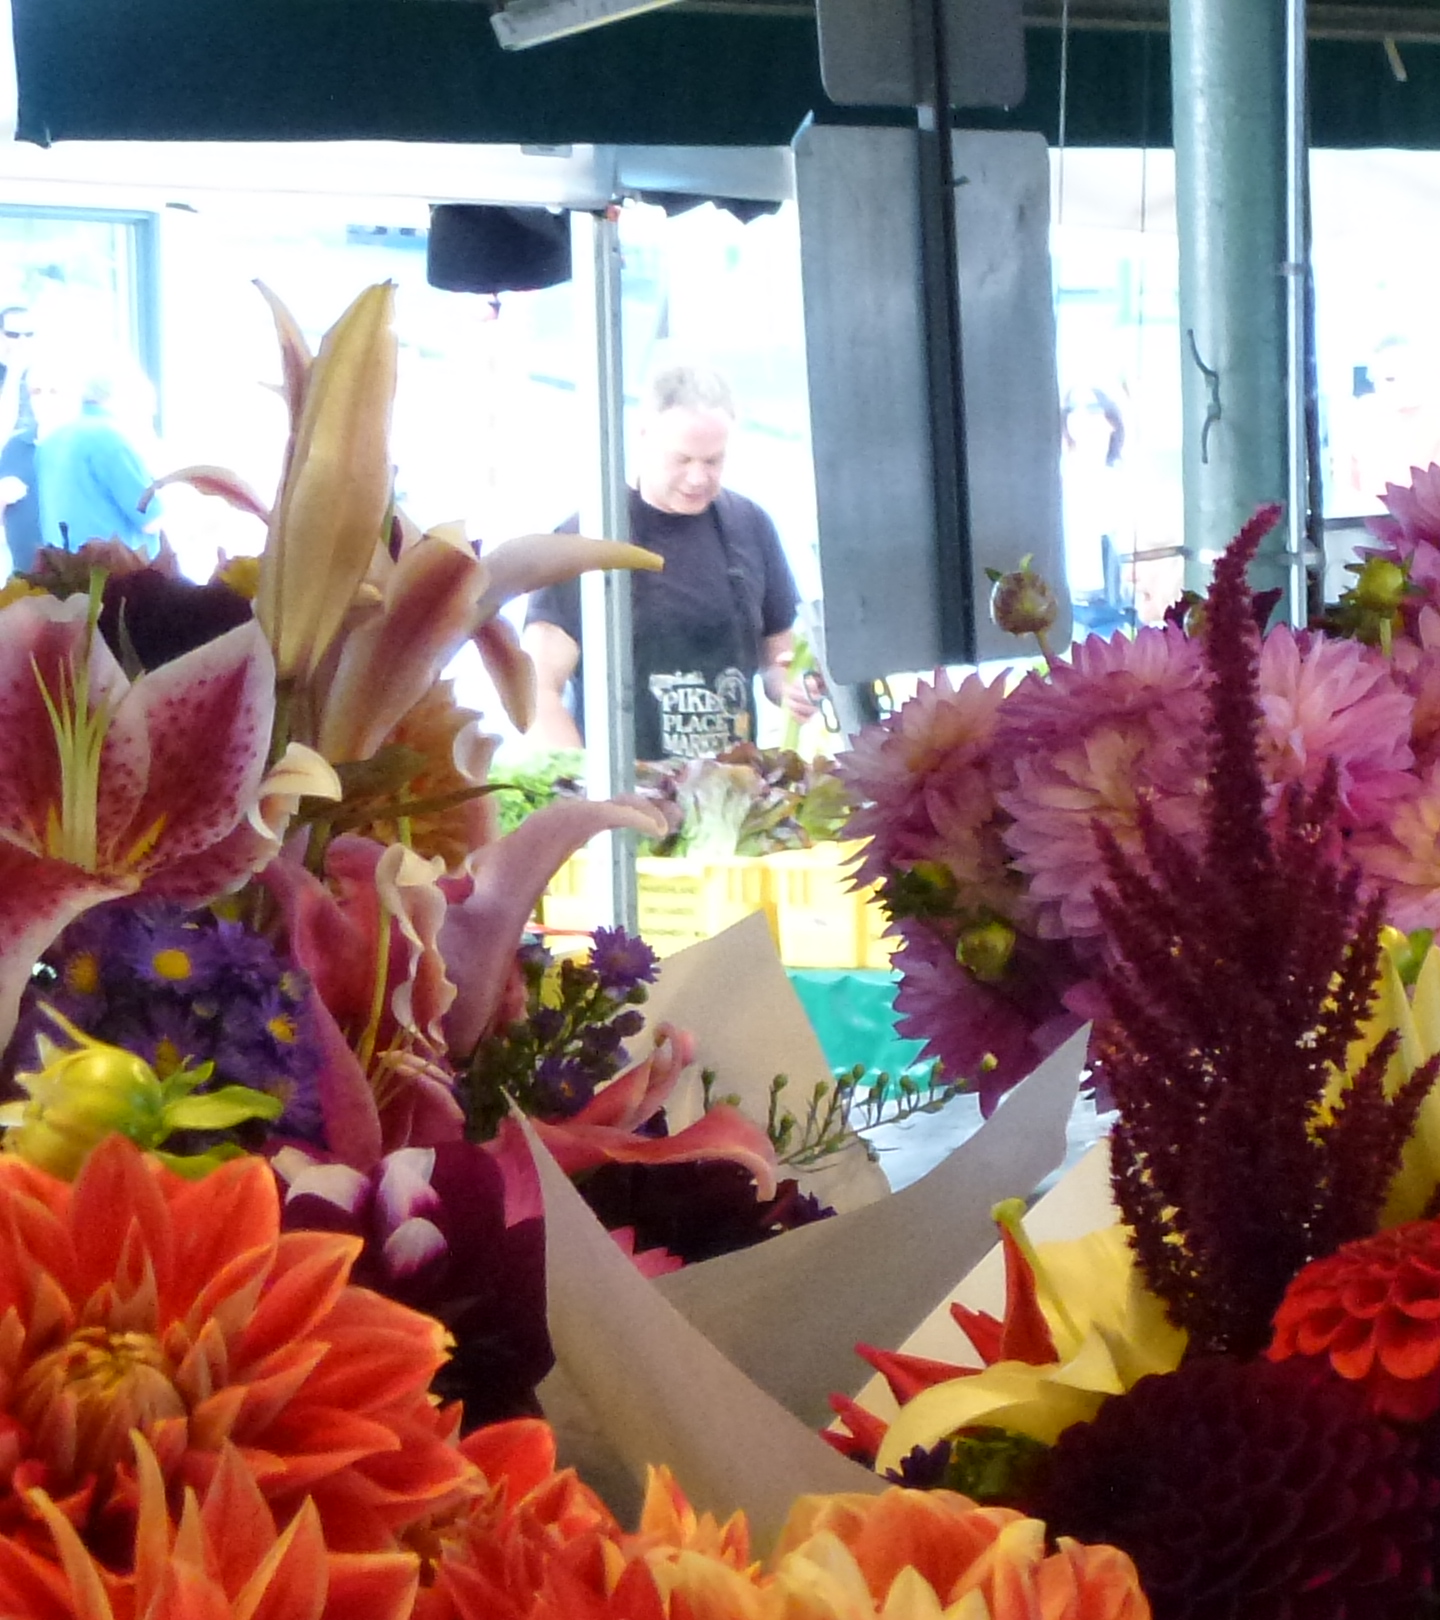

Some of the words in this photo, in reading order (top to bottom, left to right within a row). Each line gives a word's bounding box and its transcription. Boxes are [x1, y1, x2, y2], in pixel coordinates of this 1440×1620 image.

[662, 687, 723, 712] PIKE
[662, 713, 729, 733] PLACE
[662, 733, 732, 758] MARKET
